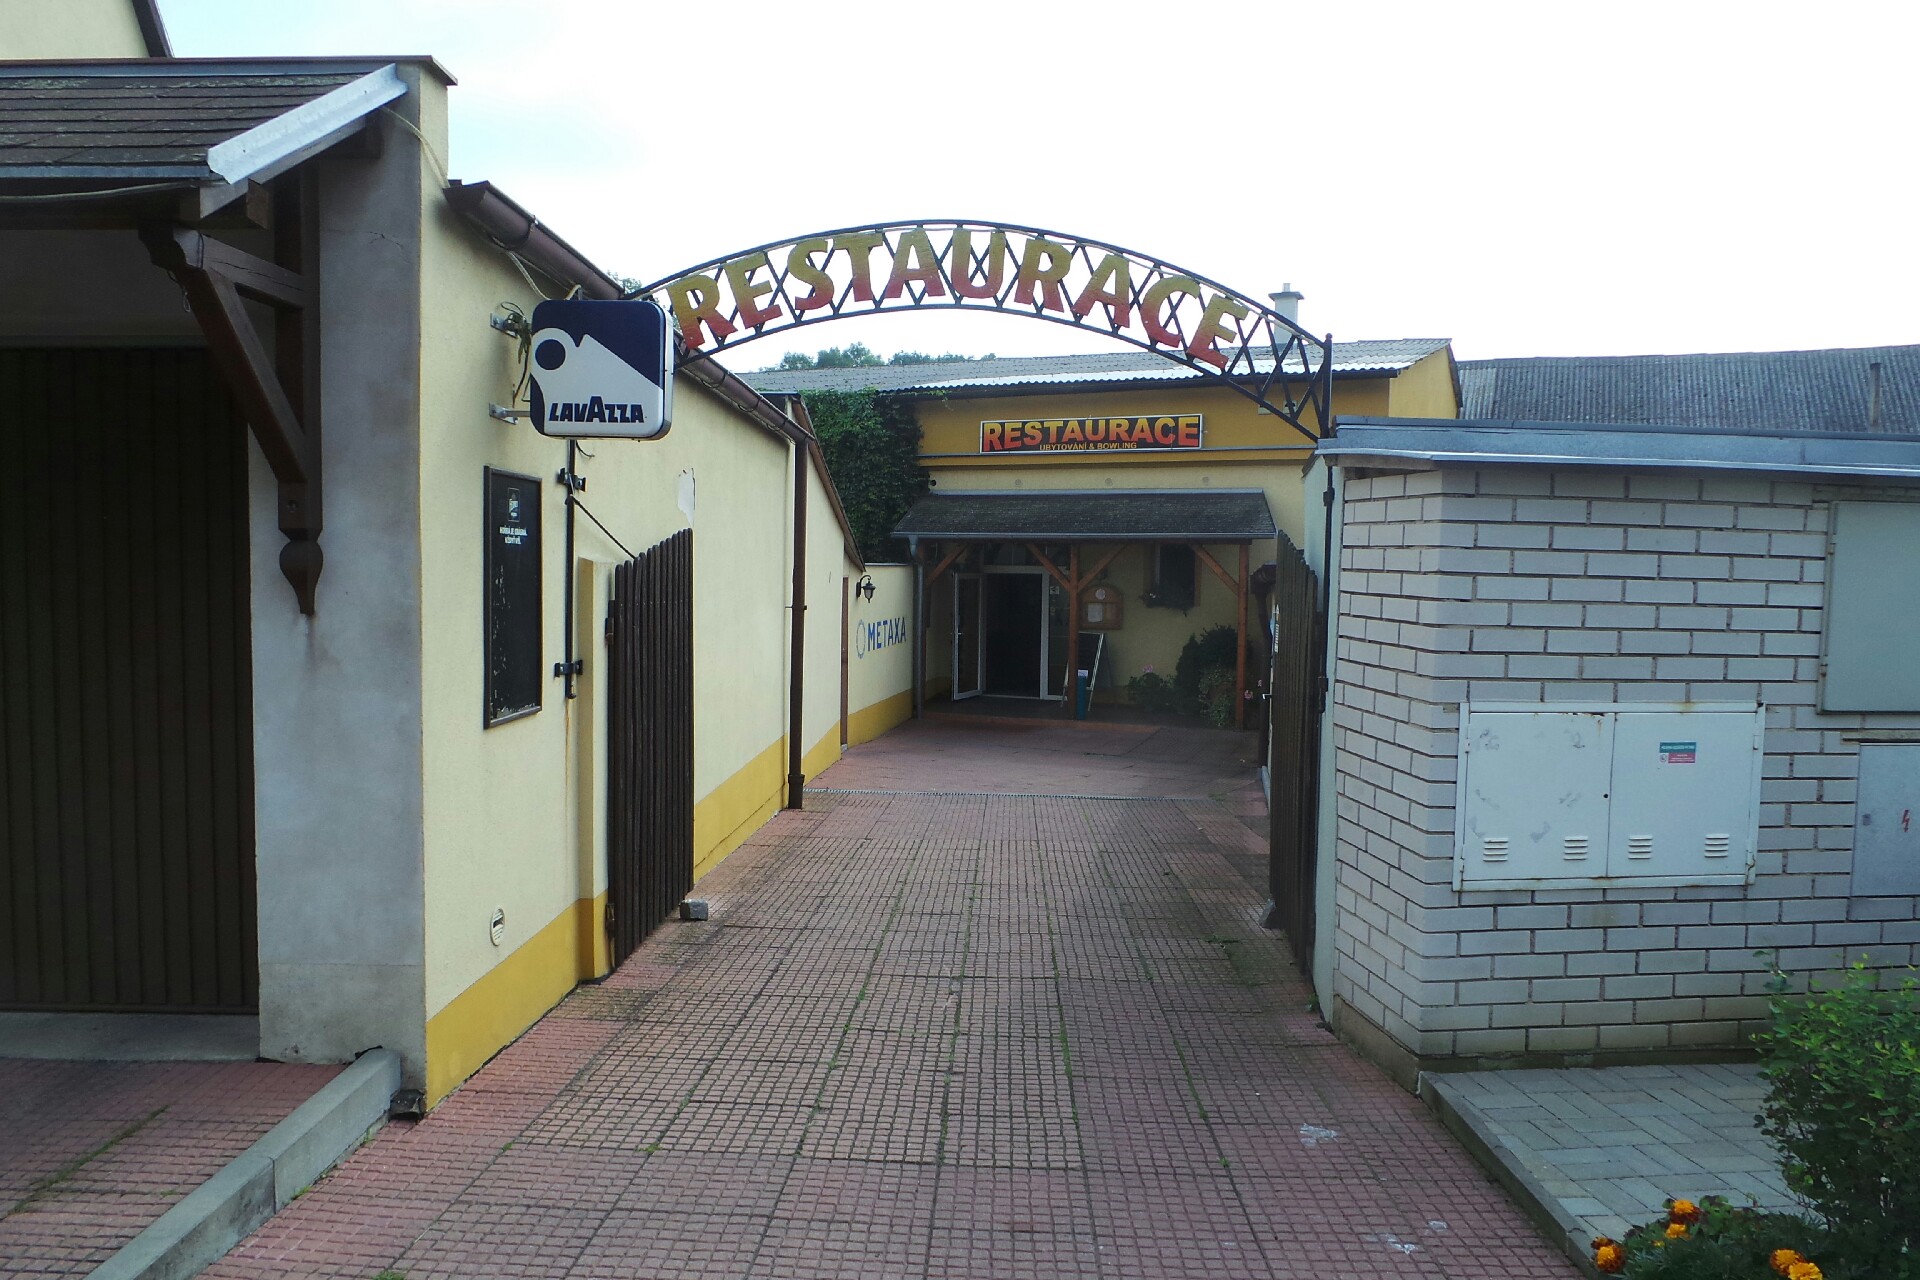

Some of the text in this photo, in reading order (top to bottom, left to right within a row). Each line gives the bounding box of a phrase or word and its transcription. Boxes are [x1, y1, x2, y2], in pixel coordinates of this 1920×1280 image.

[666, 228, 1249, 371] RESTAURACE
[548, 396, 645, 423] LAVAZZA
[983, 416, 1199, 451] RESTAURACE
[1089, 442, 1095, 450] &
[1097, 442, 1137, 450] BOWLING
[867, 616, 907, 652] METAXA
